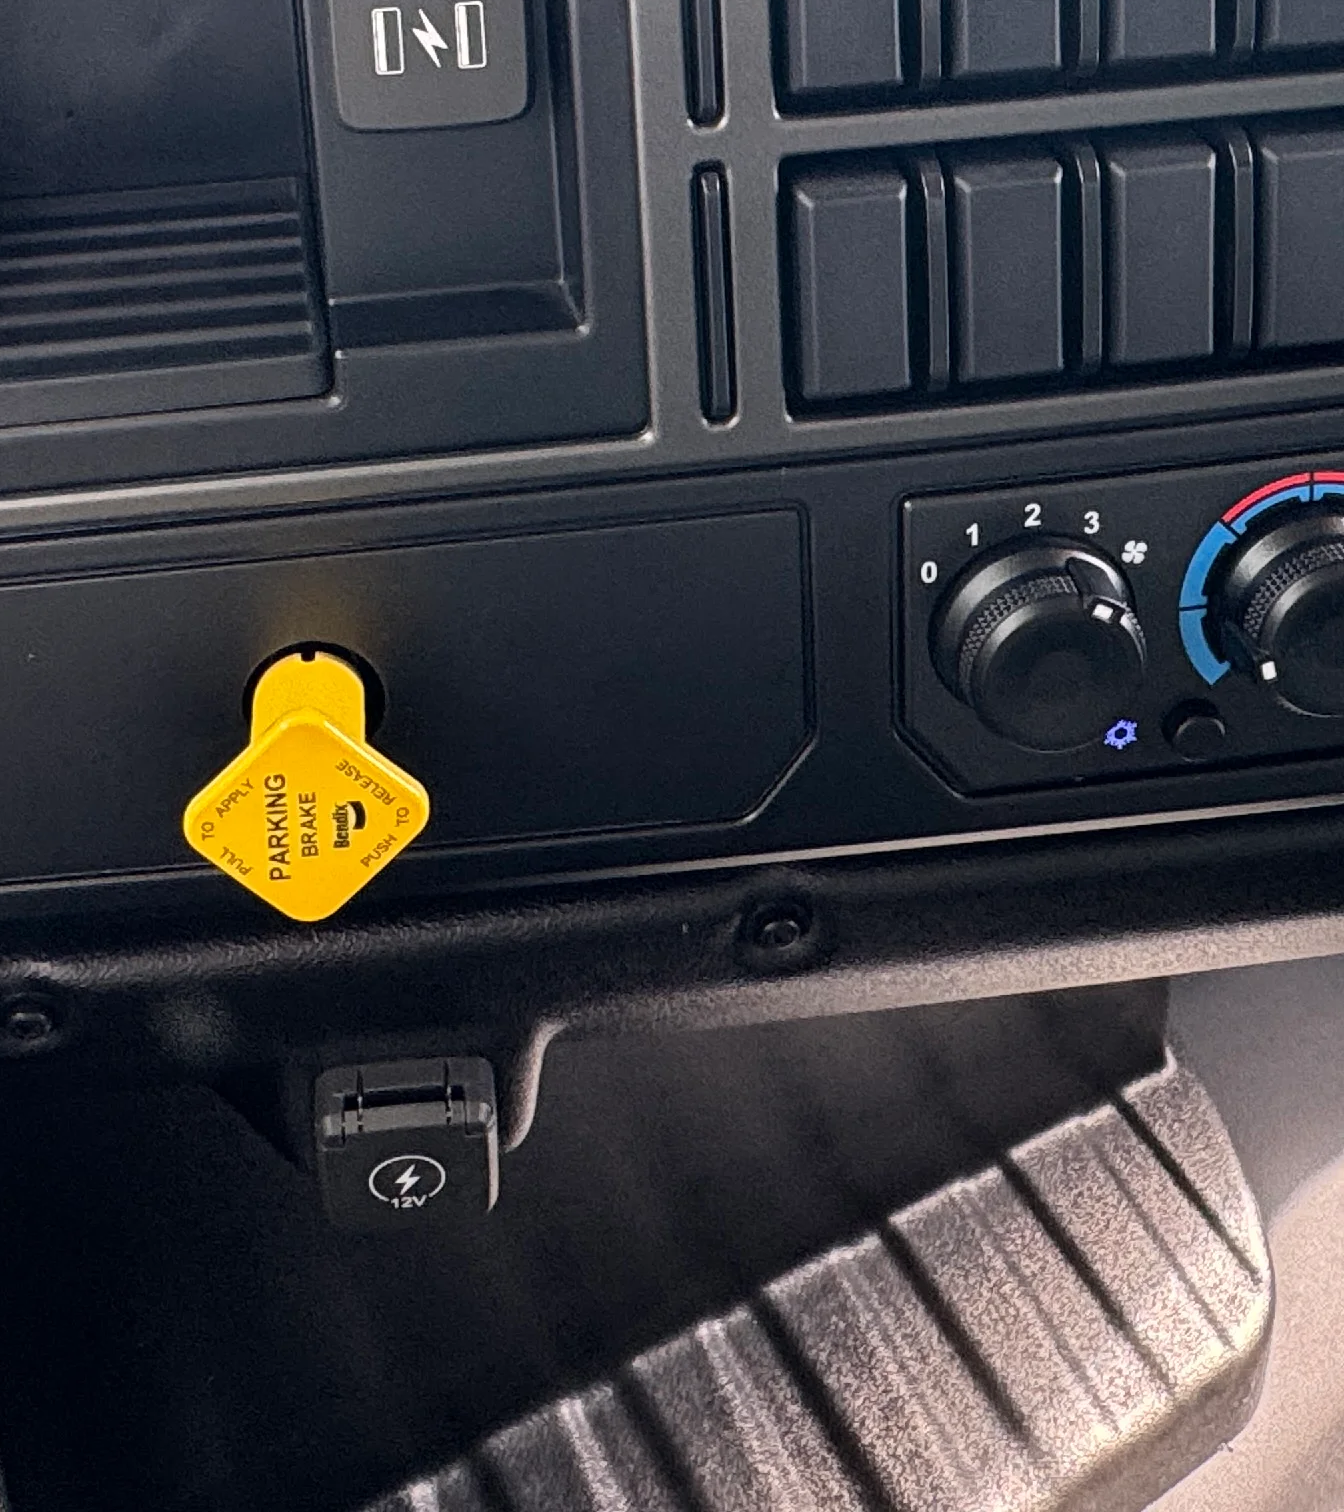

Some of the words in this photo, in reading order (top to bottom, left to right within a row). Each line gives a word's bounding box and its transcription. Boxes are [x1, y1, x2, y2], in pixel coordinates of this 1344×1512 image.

[1023, 504, 1042, 527] 2
[1083, 511, 1101, 534] 3
[966, 523, 980, 546] 1
[920, 561, 939, 584] 0
[335, 758, 396, 806] RELEASE
[215, 777, 255, 818] APPLY
[264, 773, 291, 881] PARKING
[298, 791, 320, 858] BRAKE
[330, 802, 351, 849] Bendix
[394, 806, 410, 828] TO
[201, 821, 215, 842] TO
[219, 846, 253, 876] PULL
[360, 833, 398, 868] PUSH
[390, 1194, 428, 1209] 12V
